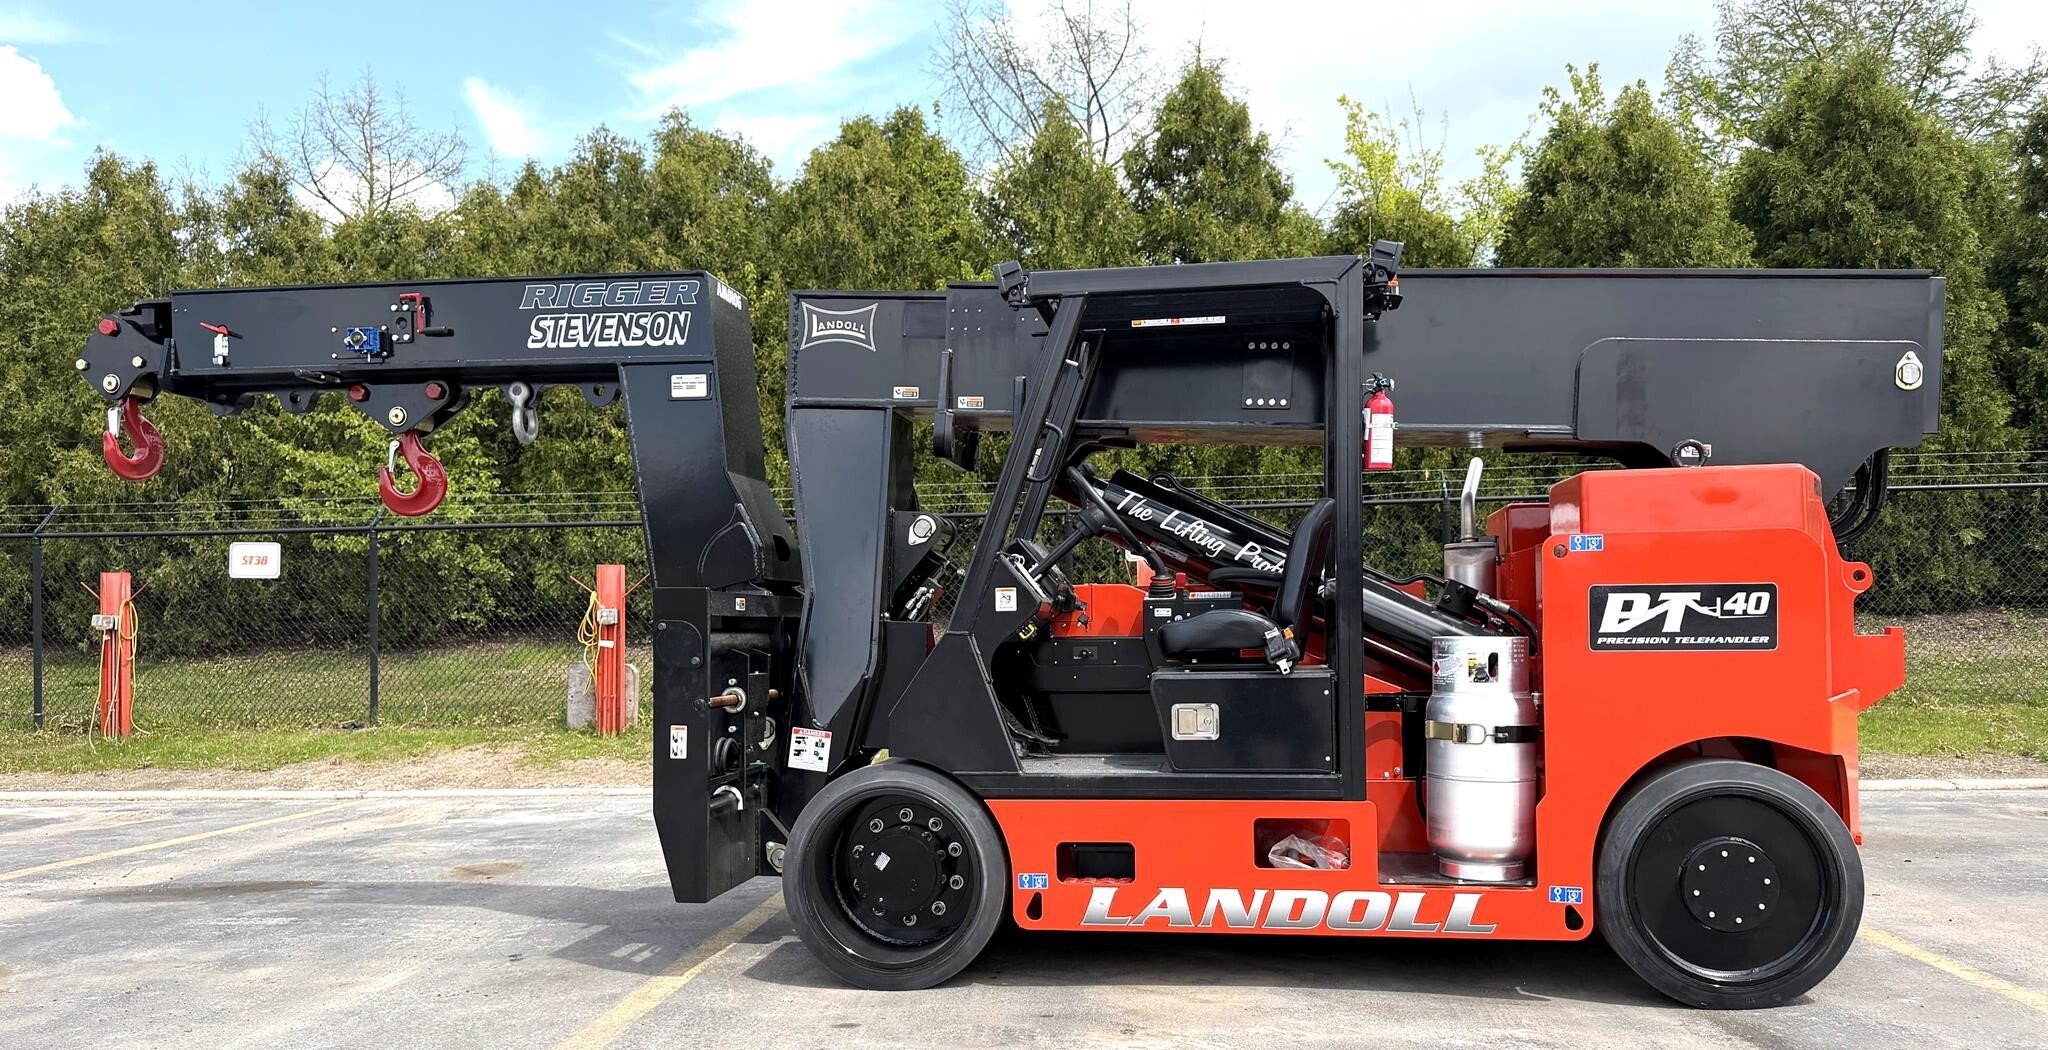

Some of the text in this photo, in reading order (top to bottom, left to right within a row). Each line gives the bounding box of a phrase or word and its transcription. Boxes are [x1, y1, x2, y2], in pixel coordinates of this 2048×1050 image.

[519, 280, 700, 310] RIGGER
[527, 311, 692, 349] STEVENSON
[811, 313, 866, 340] LANDOLL
[1116, 489, 1152, 522] The
[1159, 510, 1226, 558] Lifting
[241, 555, 268, 566] ST38
[1596, 635, 1770, 645] PRECISION TELEHANDLER
[1079, 887, 1499, 934] LANDOLL
